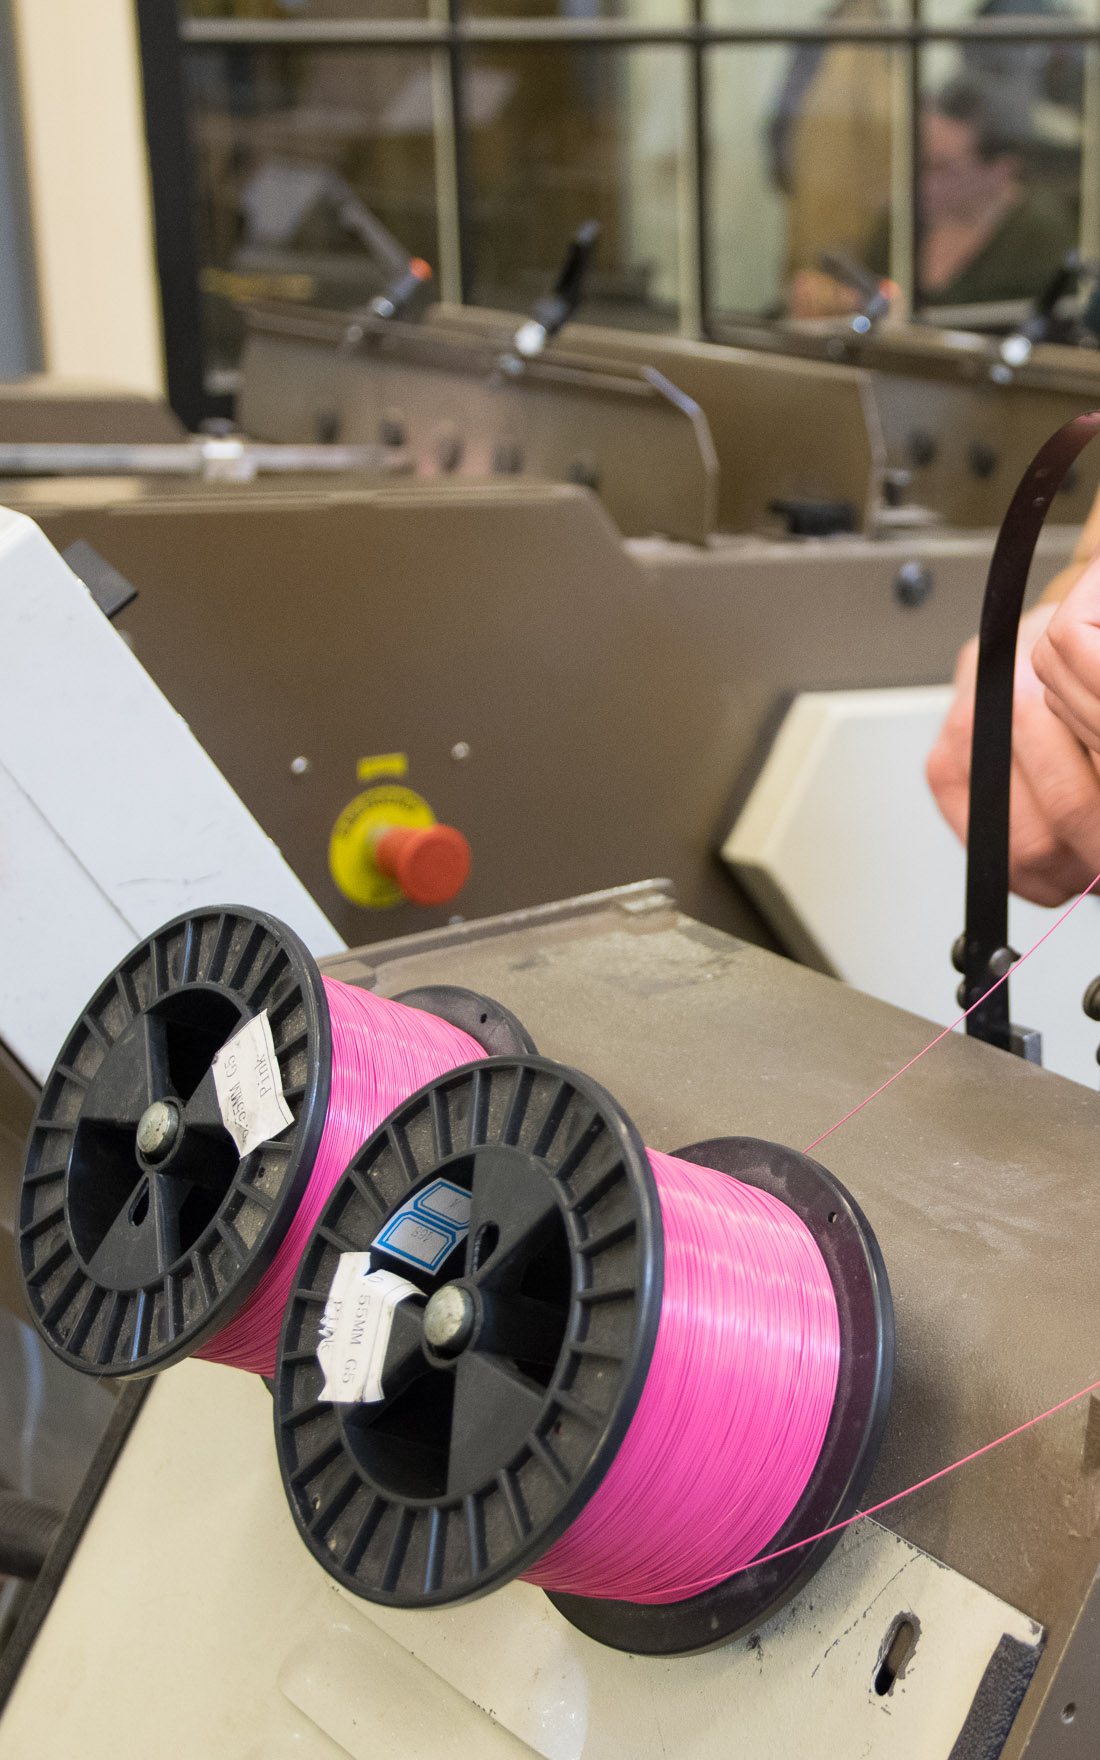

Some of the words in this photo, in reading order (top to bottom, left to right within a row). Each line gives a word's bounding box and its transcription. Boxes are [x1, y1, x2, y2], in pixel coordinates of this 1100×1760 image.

[223, 1054, 238, 1078] G5
[254, 1053, 272, 1098] Pink
[342, 1357, 358, 1384] G5
